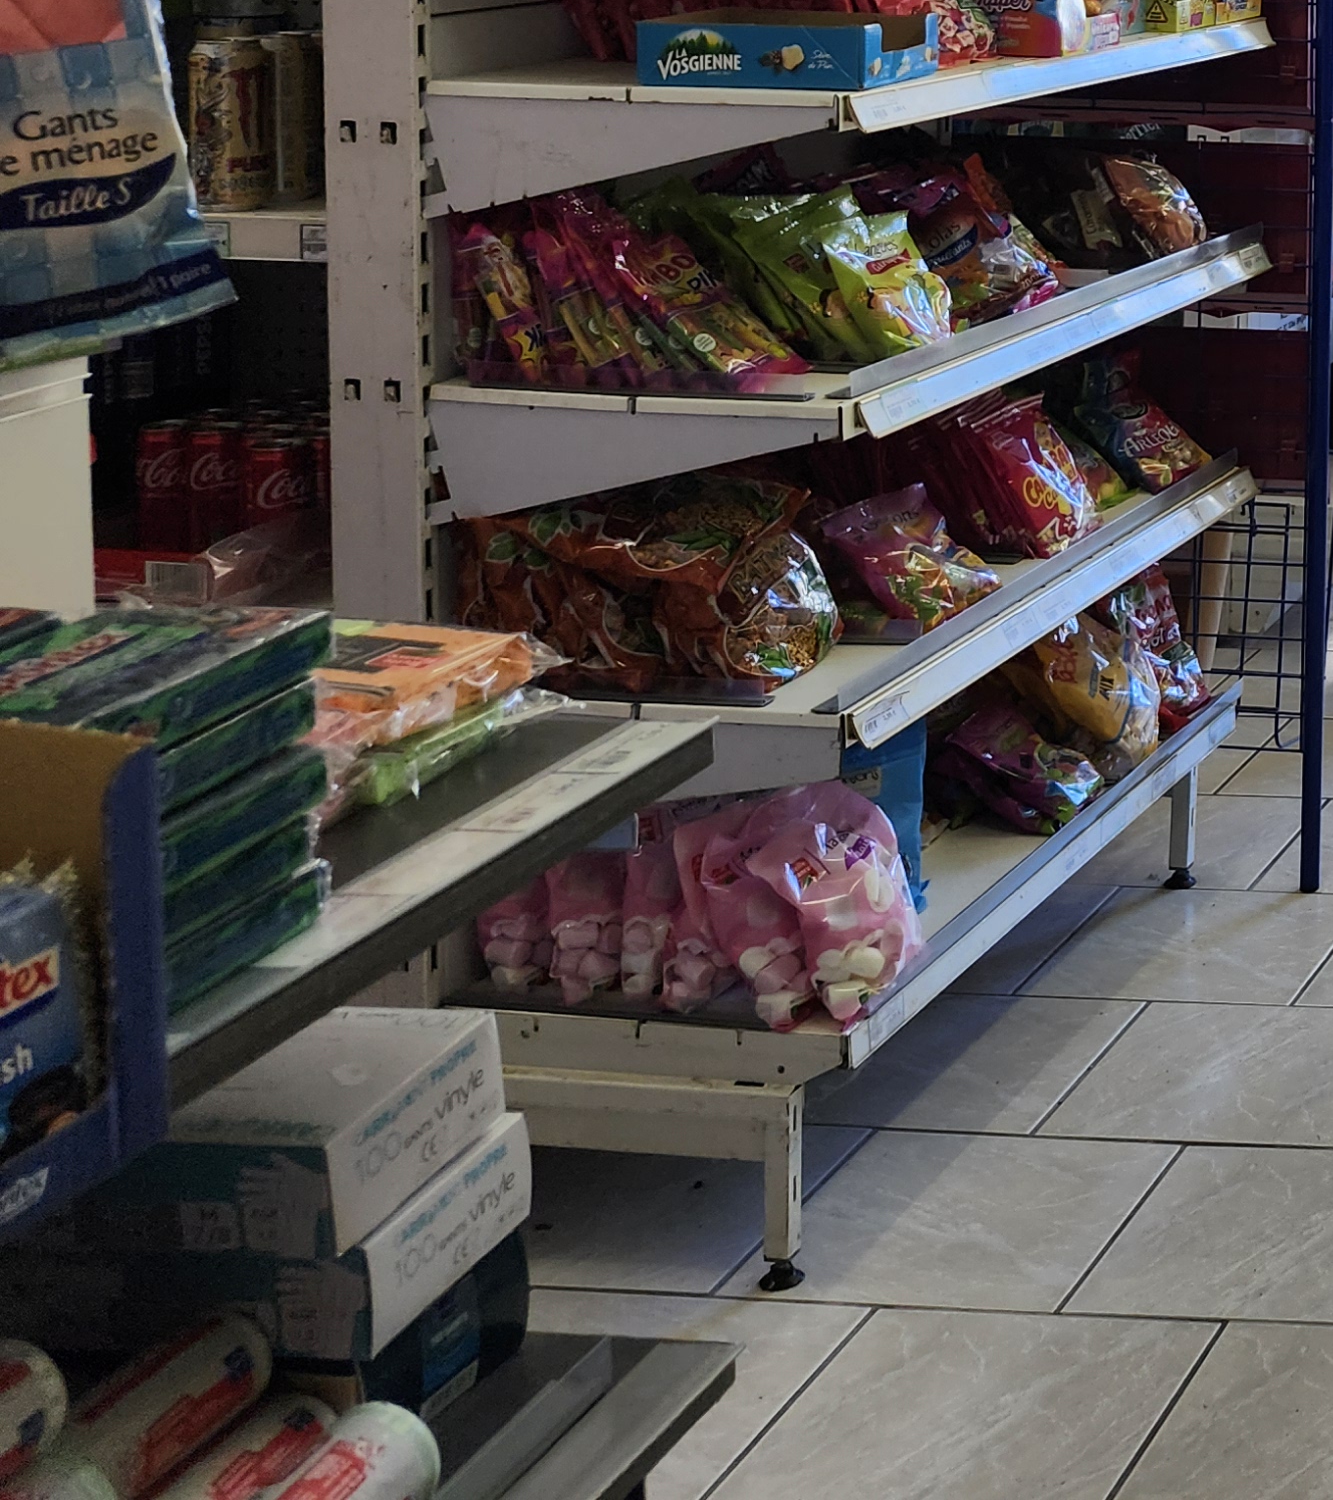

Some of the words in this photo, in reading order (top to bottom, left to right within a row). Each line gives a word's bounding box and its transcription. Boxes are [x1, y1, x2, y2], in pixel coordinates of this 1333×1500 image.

[657, 51, 742, 81] VOSGIENNE
[675, 48, 688, 59] LA
[13, 107, 119, 141] Gants
[31, 131, 158, 173] ménage
[18, 184, 111, 223] Taille
[116, 176, 133, 206] S
[434, 1066, 486, 1121] vinyle
[467, 1169, 517, 1223] vinyle
